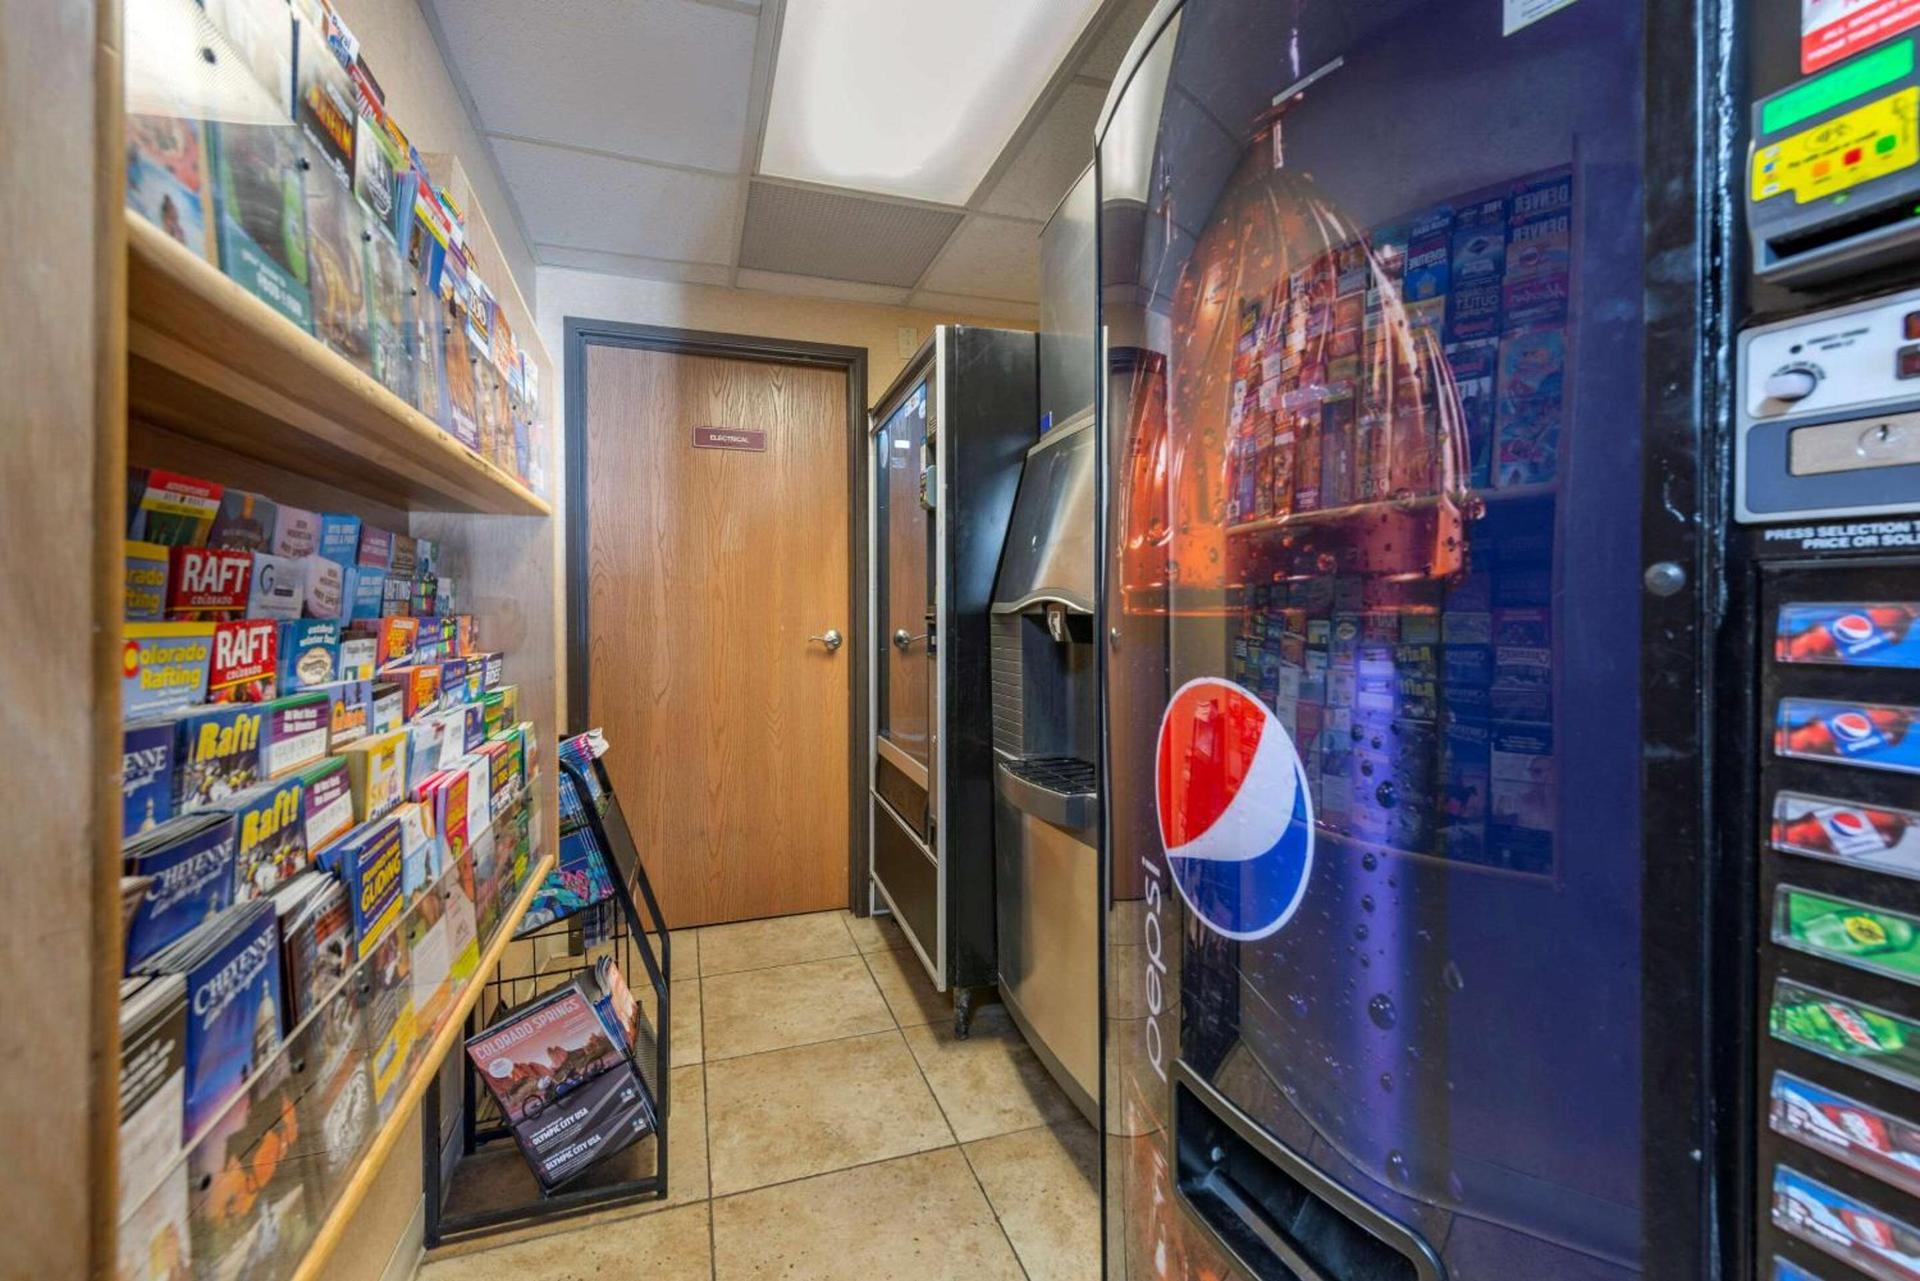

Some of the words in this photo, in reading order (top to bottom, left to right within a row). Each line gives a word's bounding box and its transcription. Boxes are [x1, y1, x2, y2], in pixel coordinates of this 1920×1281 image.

[1764, 526, 1814, 541] PRESS
[1817, 523, 1911, 539] SELECTION
[1803, 535, 1850, 550] PRICE
[1853, 534, 1879, 548] OR
[1881, 532, 1920, 548] SOL
[126, 567, 164, 586] rado
[182, 553, 250, 594] RAFT
[191, 595, 234, 606] COLORADO
[216, 625, 273, 670] RAFT
[140, 665, 201, 692] Rafting
[226, 666, 263, 680] COLORADO
[196, 713, 261, 764] Raft!
[124, 745, 167, 775] ENNE
[240, 785, 299, 853] Raft!
[193, 924, 276, 1016] CHEYENNE
[1141, 856, 1167, 1082] pepsi
[475, 1024, 533, 1060] COLORADO
[533, 998, 581, 1029] SPRINGS
[532, 1121, 561, 1146] OLYMPIC
[561, 1115, 575, 1133] CITY
[574, 1107, 589, 1125] USA
[573, 1142, 588, 1157] CITY
[587, 1134, 602, 1150] USA
